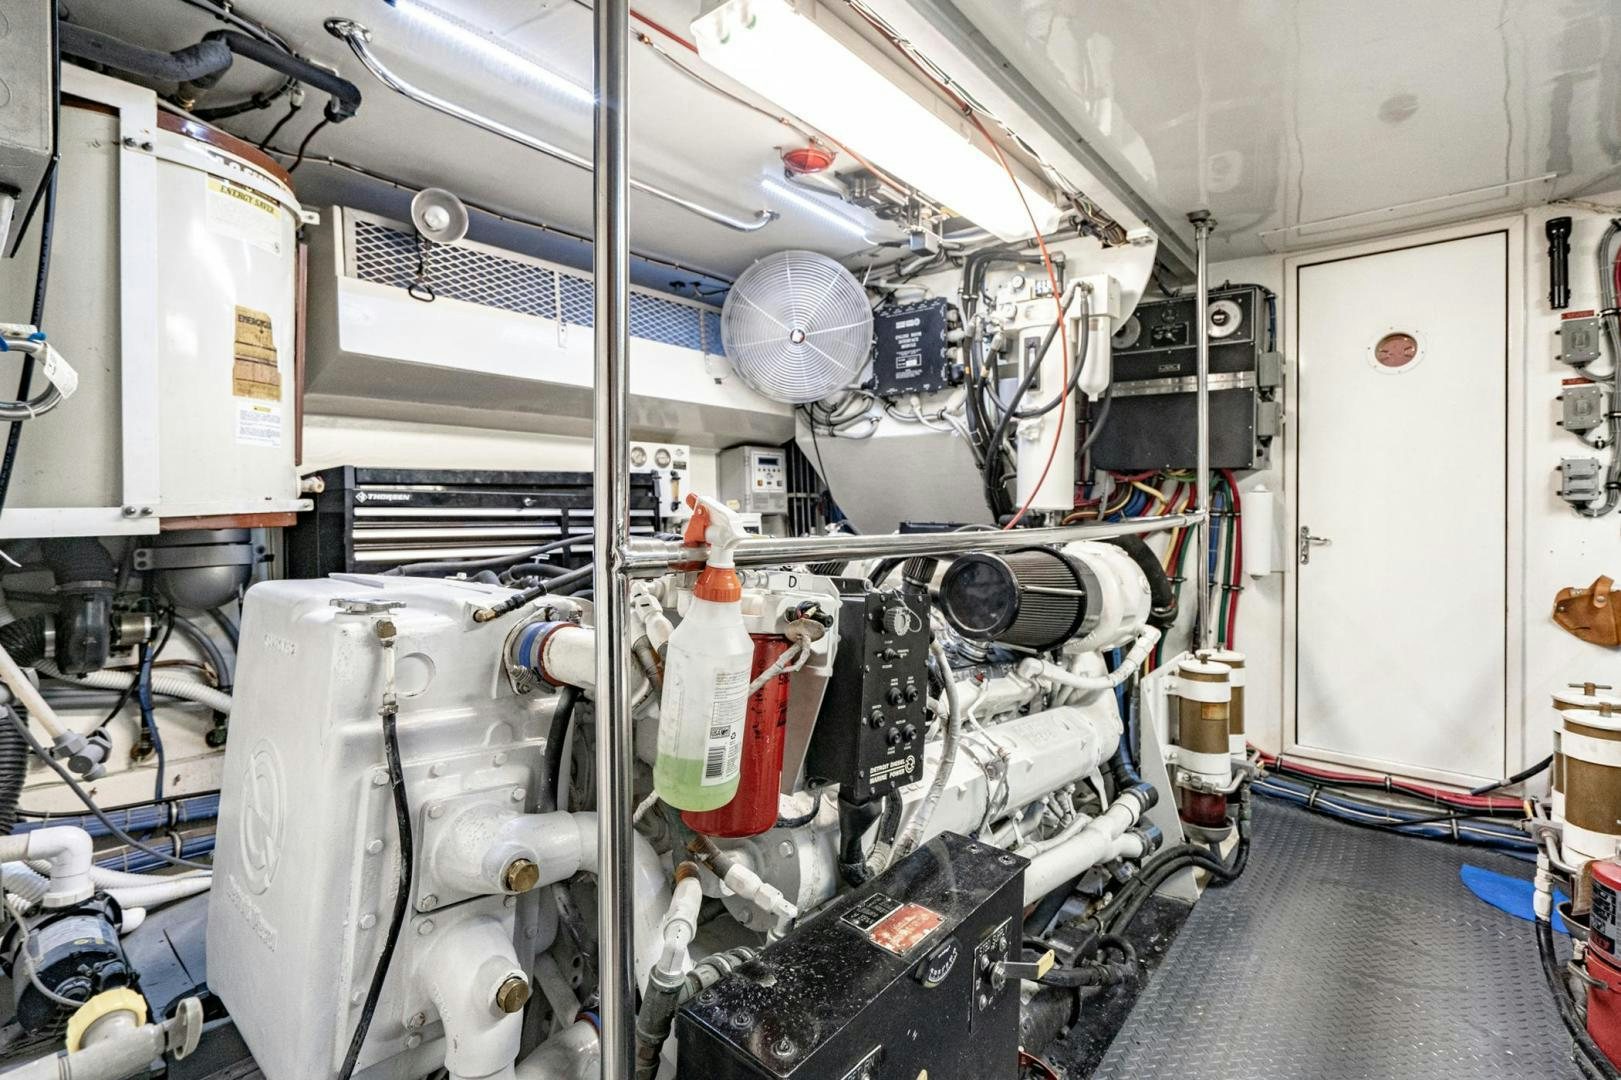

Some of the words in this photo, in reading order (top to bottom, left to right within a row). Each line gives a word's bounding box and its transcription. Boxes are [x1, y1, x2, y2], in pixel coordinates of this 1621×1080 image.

[220, 184, 253, 203] ENERGY
[254, 198, 275, 214] SAVER
[367, 493, 410, 502] THORSEN
[788, 575, 798, 589] D
[869, 763, 889, 774] DETROIT
[890, 759, 906, 768] DIESEL
[869, 773, 888, 784] MARINE
[889, 768, 905, 779] POWER
